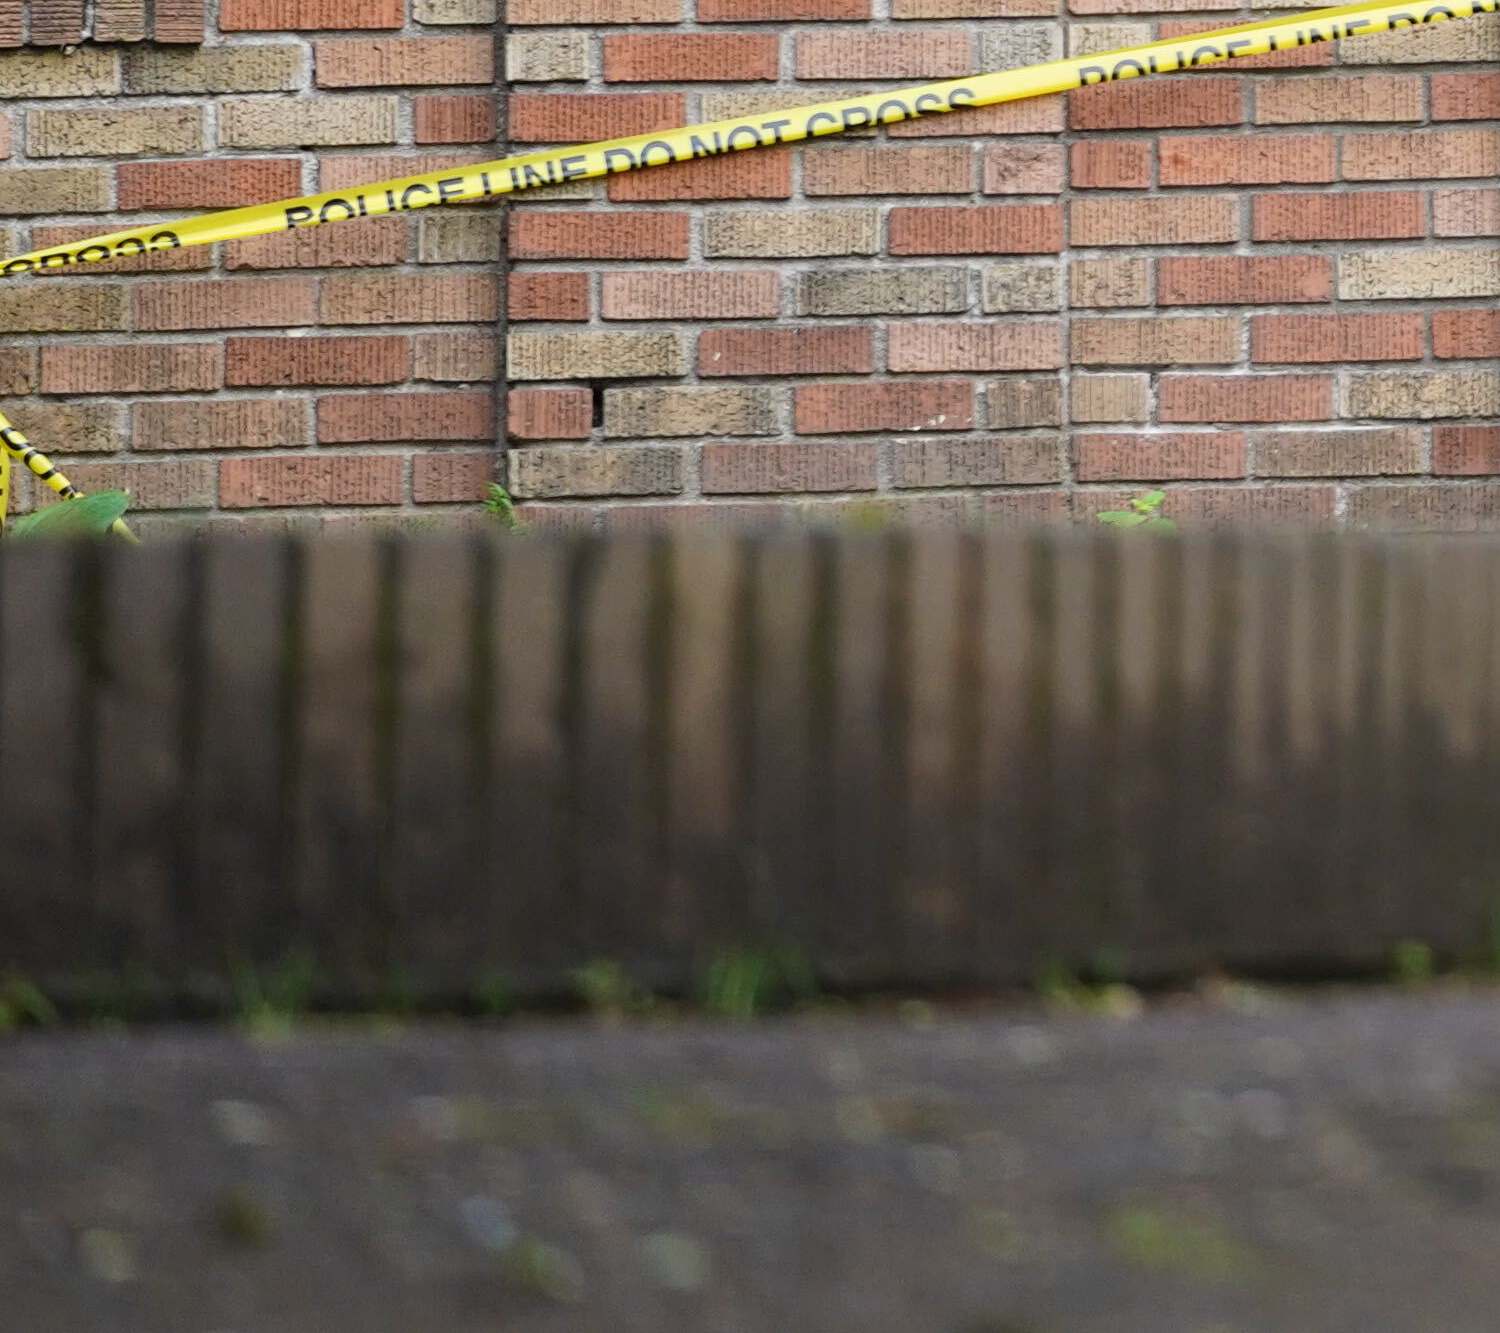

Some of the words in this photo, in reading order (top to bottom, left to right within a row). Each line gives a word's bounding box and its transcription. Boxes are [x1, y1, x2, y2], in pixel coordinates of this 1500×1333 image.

[285, 176, 466, 229] POLICE
[481, 154, 588, 195] LINE
[604, 140, 675, 174] DO
[690, 119, 791, 158] NOT
